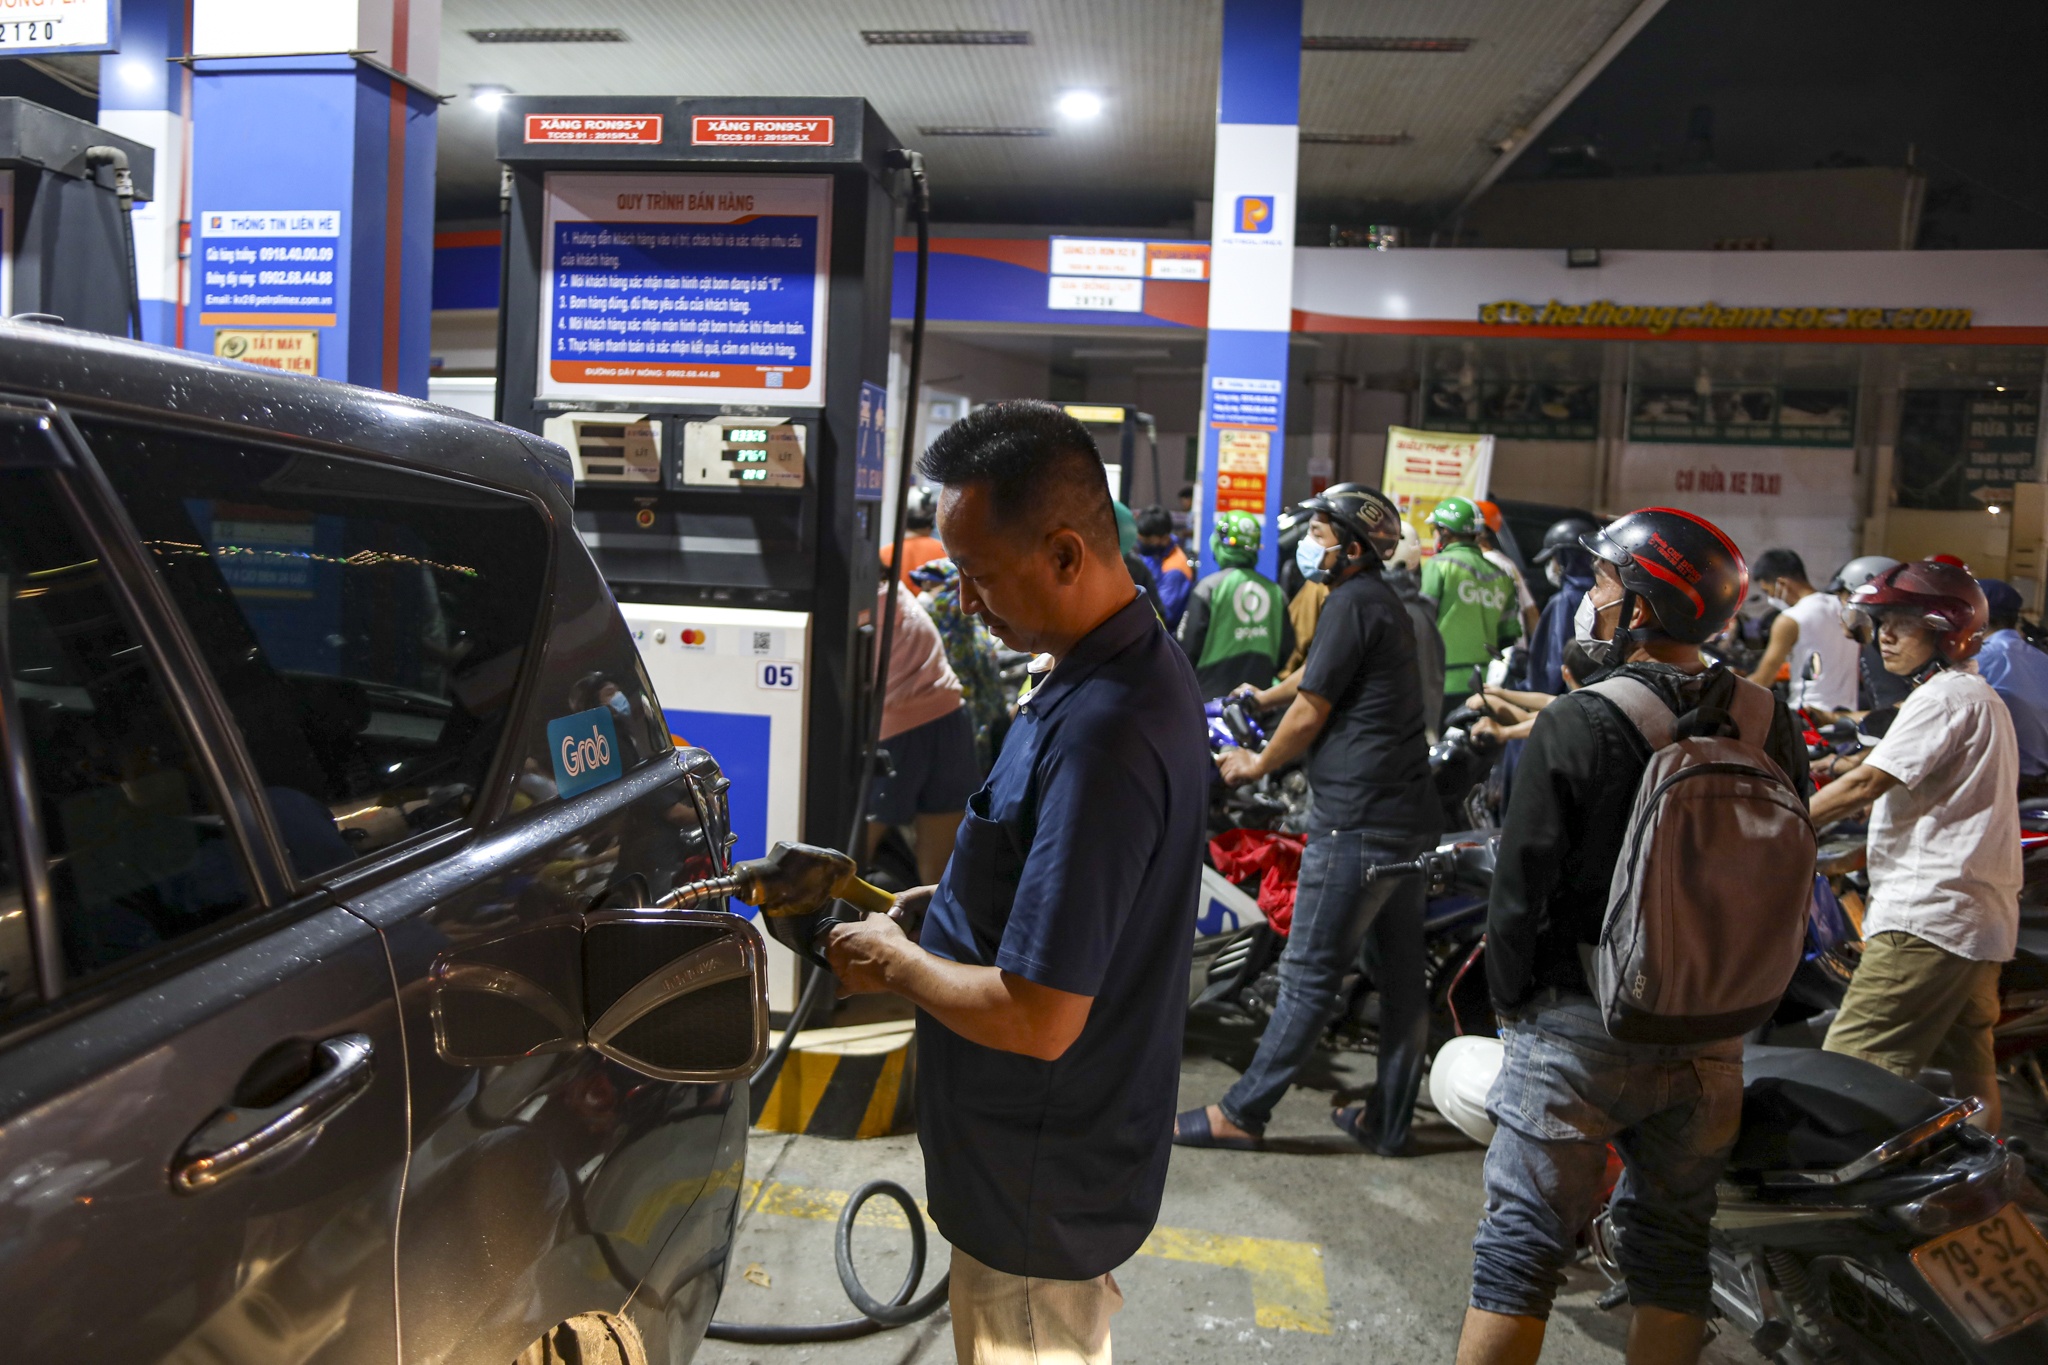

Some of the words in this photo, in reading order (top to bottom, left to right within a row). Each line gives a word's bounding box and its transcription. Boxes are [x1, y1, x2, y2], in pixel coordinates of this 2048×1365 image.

[540, 118, 582, 130] XĂNG
[584, 120, 648, 130] RON95-V
[708, 120, 750, 132] XĂNG
[753, 122, 818, 132] RON95-V
[547, 132, 574, 140] TCCS
[617, 193, 644, 210] QUY
[647, 190, 684, 210] TRÌNH
[688, 191, 714, 210] BÁN
[718, 191, 754, 211] HÀNG
[231, 216, 266, 230] THÔNG
[270, 218, 286, 230] TIN
[291, 216, 314, 230] LIÊN
[319, 216, 333, 233] HỆ
[576, 253, 598, 266] khách
[259, 271, 333, 286] 0902.68.44.88
[560, 274, 568, 288] 2.
[585, 274, 608, 288] khách
[608, 274, 628, 292] hàng
[629, 274, 643, 288] xác
[644, 275, 662, 292] nhận
[680, 275, 698, 290] hình
[730, 277, 750, 294] đang
[205, 294, 232, 305] Email:
[559, 295, 567, 308] 3.
[569, 295, 587, 310] Bơm
[588, 296, 607, 312] hàng
[642, 296, 658, 310] theo
[658, 296, 674, 314] yêu
[674, 296, 688, 310] cầu
[690, 296, 704, 311] của
[704, 298, 728, 312] khách
[558, 316, 566, 330] 4.
[584, 316, 606, 330] khách
[607, 317, 626, 334] hàng
[628, 318, 642, 331] xác
[642, 318, 661, 334] nhận
[679, 318, 696, 332] hình
[762, 321, 786, 334] thanh
[253, 333, 273, 350] TẤT
[278, 336, 302, 350] MÁY
[558, 338, 566, 352] 5.
[568, 338, 588, 354] Thực
[588, 338, 605, 355] hiện
[606, 338, 628, 352] thanh
[628, 339, 645, 353] toán
[656, 340, 670, 354] xác
[670, 340, 690, 356] nhận
[722, 340, 738, 354] cảm
[750, 342, 774, 356] khách
[288, 354, 312, 372] TIỆN
[585, 366, 616, 376] ĐƯỜNG
[637, 367, 664, 376] NÓNG:
[2012, 422, 2035, 436] XE
[778, 452, 792, 461] LÍT
[1730, 471, 1747, 494] XE
[1458, 580, 1506, 610] Grab
[764, 665, 792, 686] 05
[562, 724, 610, 776] Grab
[1632, 970, 1647, 999] acer
